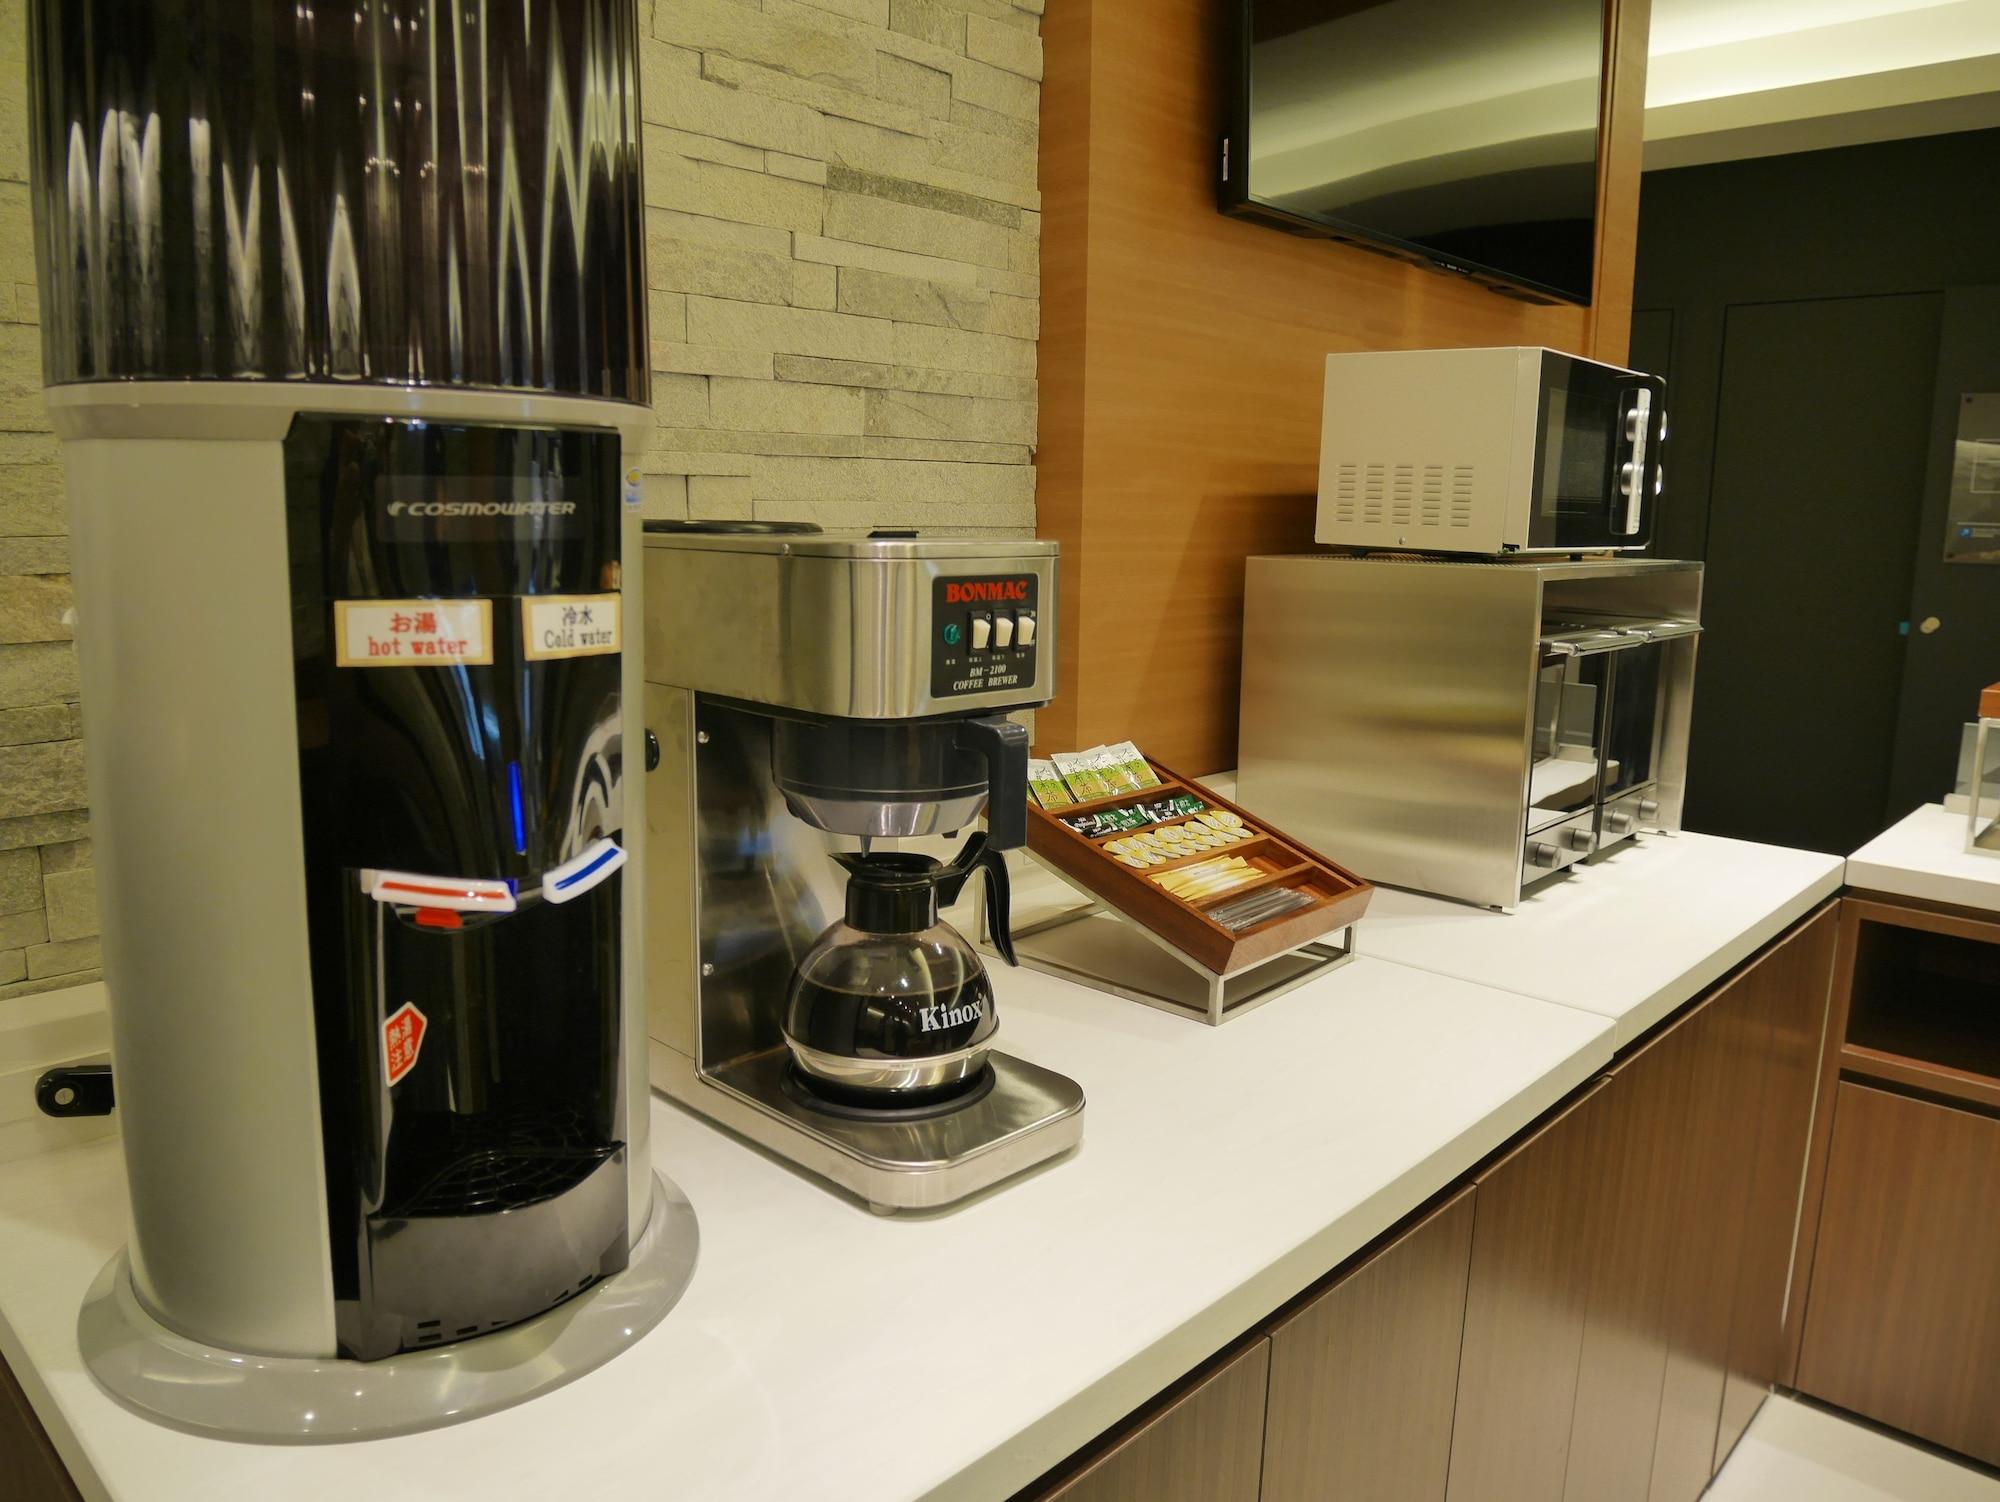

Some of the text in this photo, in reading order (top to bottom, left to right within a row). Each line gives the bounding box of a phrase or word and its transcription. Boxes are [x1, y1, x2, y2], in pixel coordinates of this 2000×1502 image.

[407, 501, 576, 516] COSMOWATER
[946, 581, 1028, 603] BONMAC
[390, 611, 437, 634] お湯
[561, 606, 593, 626] 冷水
[368, 637, 467, 656] hot water
[544, 628, 613, 649] Cold water
[953, 675, 1018, 691] COFFEE BREWER
[919, 1000, 983, 1032] Kinox
